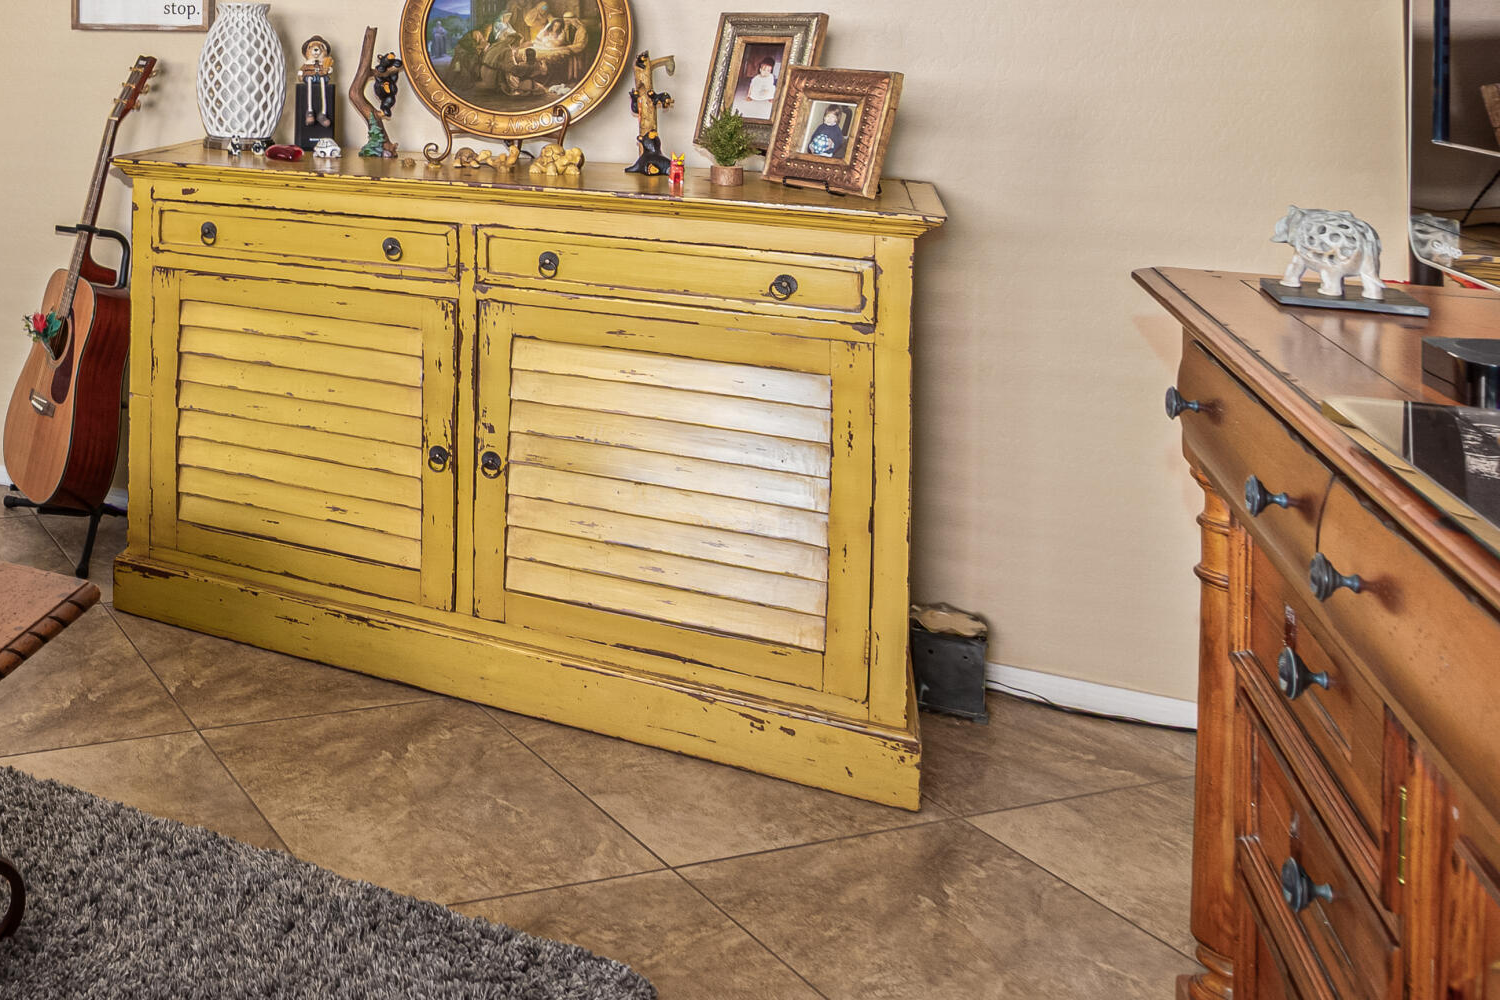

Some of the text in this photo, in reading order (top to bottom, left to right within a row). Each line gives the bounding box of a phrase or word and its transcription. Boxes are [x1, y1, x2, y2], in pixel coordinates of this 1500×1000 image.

[164, 3, 199, 19] stop.
[603, 3, 623, 19] A
[592, 26, 626, 89] CHILD
[571, 89, 593, 110] IS
